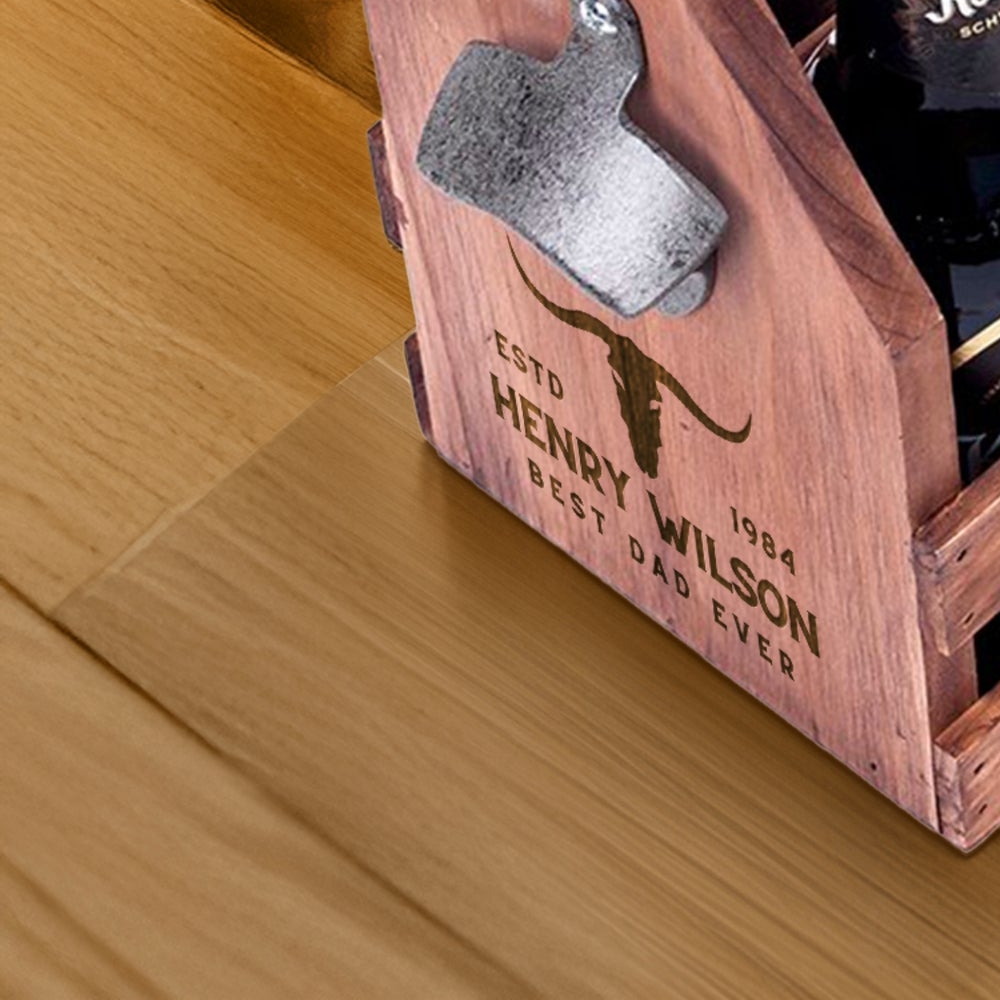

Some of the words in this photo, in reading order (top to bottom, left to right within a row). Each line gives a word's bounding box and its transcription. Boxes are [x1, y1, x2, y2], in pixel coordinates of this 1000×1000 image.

[493, 329, 564, 400] ESTD
[489, 371, 631, 511] HENRY
[646, 489, 821, 659] WILSON
[527, 457, 606, 535] BEST
[628, 533, 691, 600] DAD
[712, 598, 796, 681] EVER
[729, 505, 797, 576] 1984
